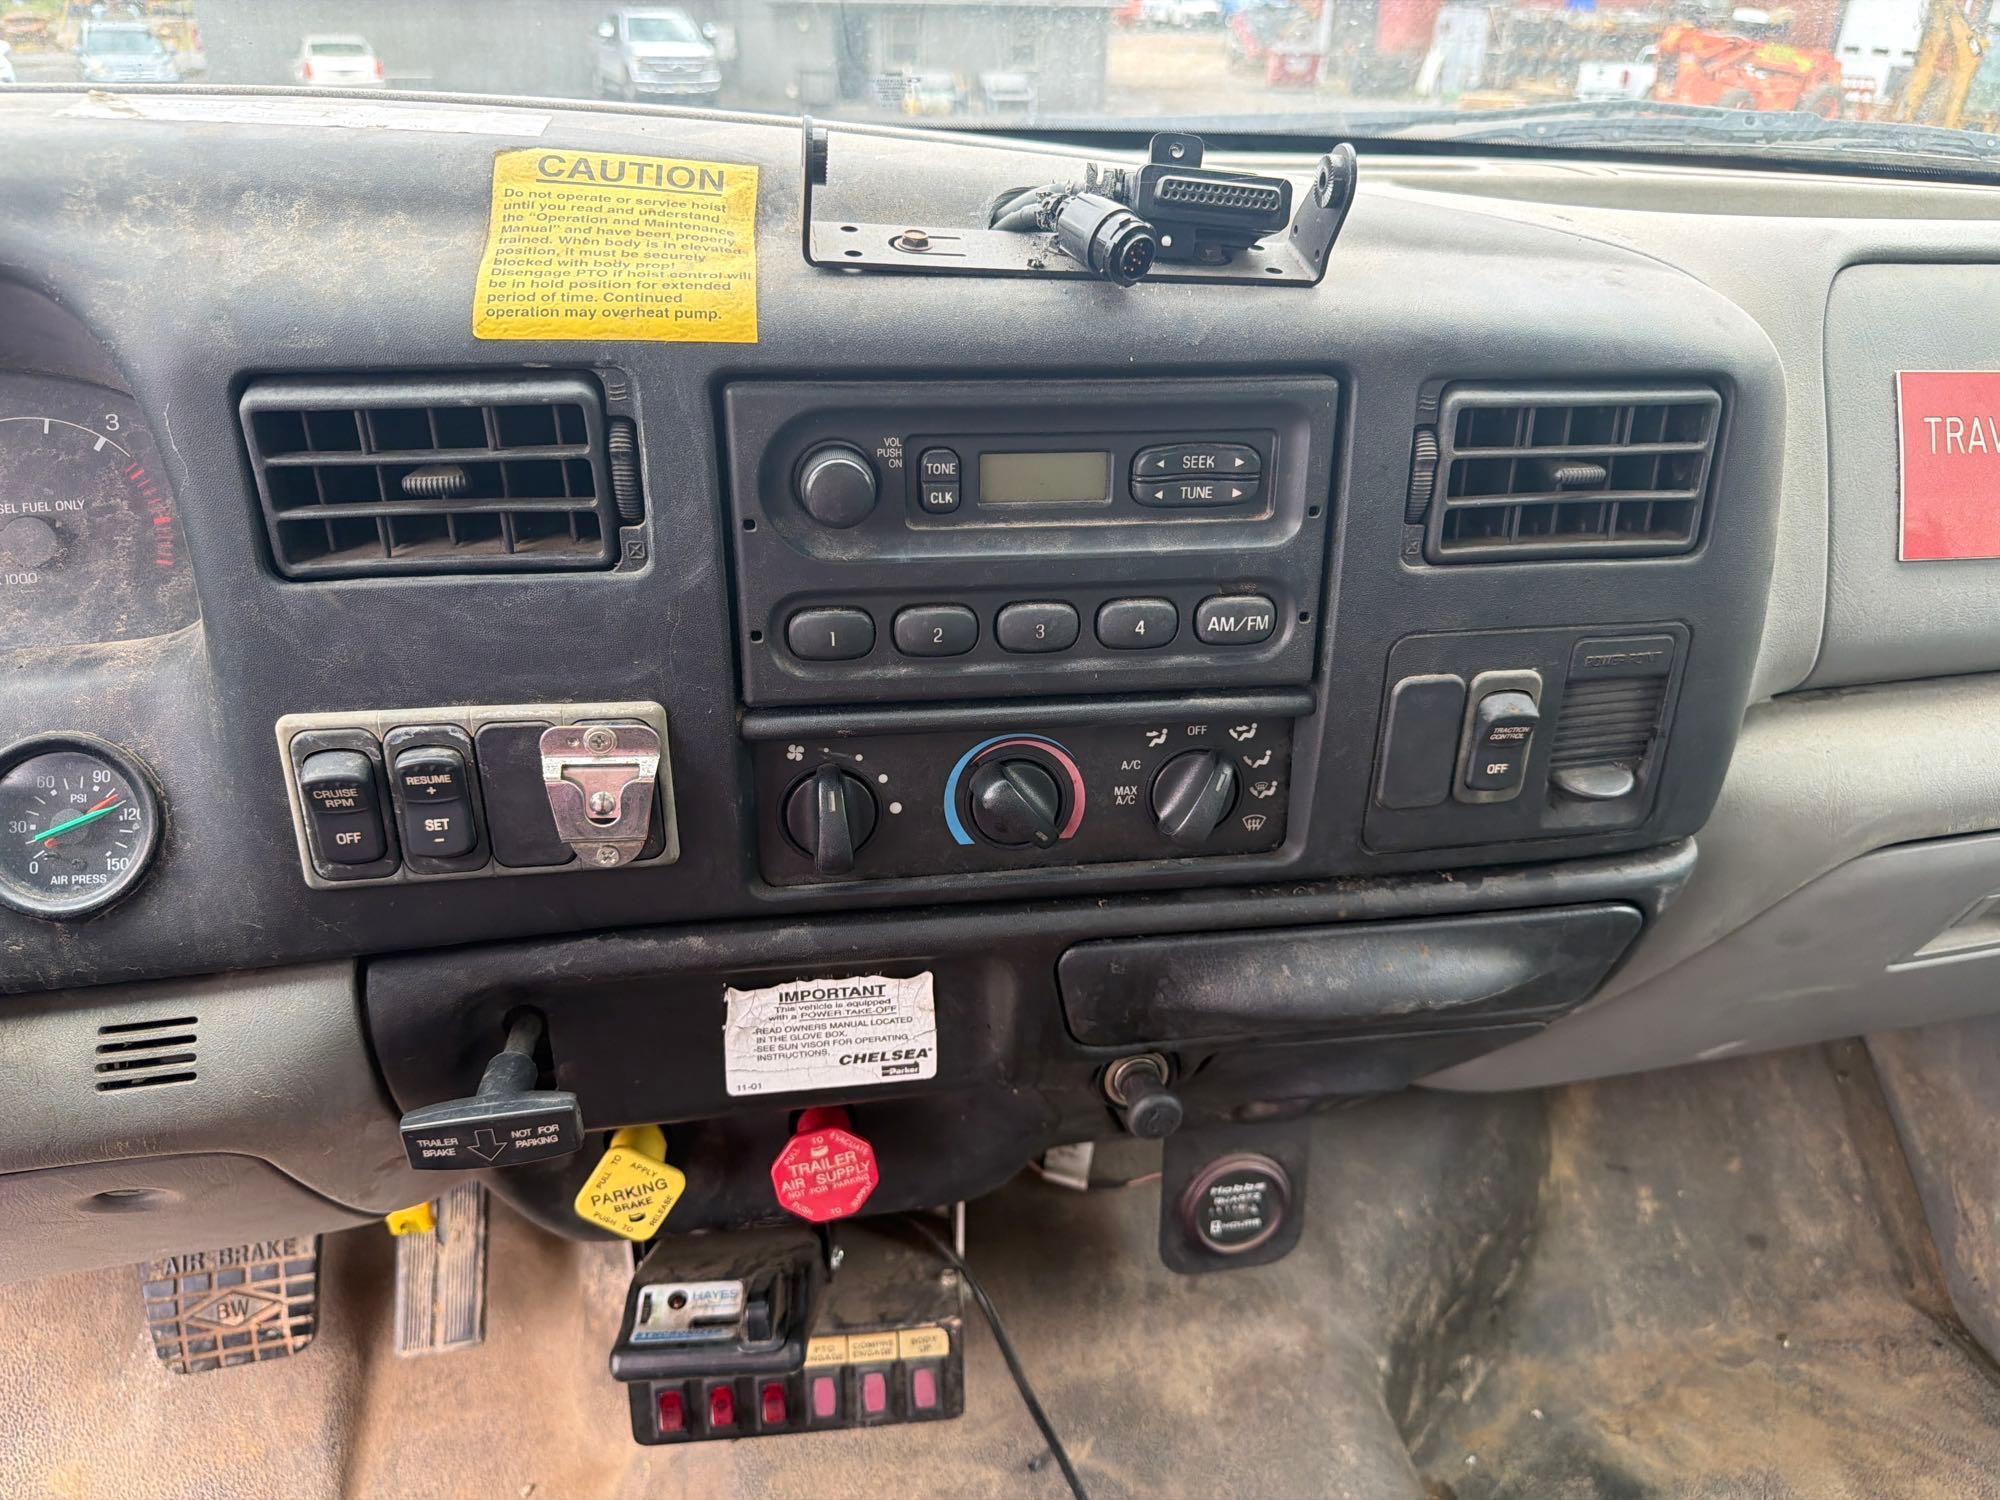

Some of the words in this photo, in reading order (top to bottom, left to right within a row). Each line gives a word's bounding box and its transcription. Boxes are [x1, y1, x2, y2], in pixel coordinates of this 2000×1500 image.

[537, 154, 725, 192] CAUTION
[504, 188, 524, 198] Do
[529, 190, 552, 199] not
[557, 193, 611, 202] operate
[636, 198, 687, 208] service
[691, 201, 727, 213] hoist
[504, 201, 534, 210] until
[540, 203, 566, 211] you
[571, 205, 603, 213] read
[607, 207, 634, 215] and
[639, 208, 720, 223] understand
[503, 213, 524, 222] the
[613, 218, 640, 226] and
[645, 219, 735, 237] Maintenance
[559, 236, 600, 246] When
[604, 238, 640, 249] body
[647, 240, 658, 249] is
[663, 241, 676, 249] in
[564, 226, 592, 234] and
[596, 227, 631, 236] have
[636, 229, 671, 239] been
[676, 232, 736, 246] properly
[495, 247, 560, 257] position,
[565, 248, 574, 256] it
[579, 249, 616, 258] must
[621, 250, 639, 258] be
[643, 252, 706, 263] securely
[493, 258, 553, 267] blocked
[557, 259, 588, 267] with
[593, 260, 630, 269] body
[636, 262, 675, 270] prop!
[491, 268, 571, 278] Disengage
[627, 270, 664, 278] hoist
[727, 272, 751, 280] will
[489, 280, 507, 288] be
[512, 280, 525, 288] in
[531, 280, 564, 288] hold
[569, 280, 631, 290] position
[636, 281, 658, 289] for
[662, 282, 731, 291] extended
[487, 292, 536, 304] period
[541, 292, 557, 302] of
[561, 292, 598, 302] time.
[603, 292, 682, 303] Continued
[486, 307, 559, 319] operation
[565, 308, 597, 320] may
[602, 307, 669, 319] overheat
[674, 309, 722, 321] pump.
[105, 414, 120, 431] 3
[884, 437, 903, 447] VOL
[877, 448, 903, 458] PUSH
[888, 459, 903, 468] ON
[1182, 455, 1215, 469] SEEK
[927, 463, 956, 475] TONE
[930, 492, 953, 504] CLK
[1180, 486, 1213, 499] TUNE
[0, 503, 19, 514] SEL
[22, 501, 52, 513] FUEL
[55, 499, 85, 511] ONLY
[5, 572, 38, 585] 1000
[1134, 620, 1145, 635] 4
[1207, 615, 1269, 632] AM/FM
[933, 627, 943, 643] 2
[1035, 624, 1045, 639] 3
[829, 631, 836, 647] 1
[1187, 725, 1208, 736] OFF
[1493, 726, 1530, 734] TRACTION
[1121, 760, 1141, 770] A/C
[1486, 763, 1510, 775] OFF
[37, 775, 55, 788] 60
[92, 770, 111, 783] 90
[405, 774, 452, 786] RESUME
[313, 788, 358, 799] CRUISE
[1114, 786, 1138, 796] MAX
[70, 794, 87, 803] PSI
[325, 798, 355, 808] RPM
[1116, 795, 1136, 805] A/C
[9, 820, 27, 833] 30
[424, 818, 449, 831] SET
[335, 832, 362, 845] OFF
[29, 862, 39, 874] 0
[106, 858, 129, 871] 150
[50, 875, 68, 885] AIR
[72, 874, 107, 884] PRESS
[779, 984, 886, 1002] IMPORTANT
[798, 1003, 833, 1011] vehicle
[846, 999, 891, 1007] equipped
[800, 1010, 841, 1019] POWER
[845, 1005, 897, 1015] TAKE-OFF
[784, 1023, 827, 1033] OWNERS
[829, 1020, 869, 1029] MANUAL
[870, 1016, 913, 1026] LOCATED
[778, 1043, 798, 1051] SUN
[800, 1040, 830, 1049] VISOR
[832, 1038, 852, 1046] FOR
[854, 1033, 909, 1045] OPERATING
[790, 1032, 822, 1041] GLOVE
[839, 1048, 929, 1065] CHELSEA
[737, 1082, 763, 1091] 11-01
[511, 1128, 532, 1139] NOT
[537, 1124, 560, 1135] FOR
[416, 1137, 458, 1147] TRAILER
[515, 1134, 559, 1149] PARKING
[422, 1148, 456, 1158] BRAKE
[789, 1150, 857, 1178] TRAILER
[596, 1172, 613, 1189] PULL
[611, 1154, 622, 1165] TO
[630, 1162, 658, 1177] APPLY
[781, 1178, 806, 1192] AIR
[816, 1160, 870, 1185] SUPPLY
[591, 1178, 668, 1207] PARKING
[788, 1189, 806, 1199] NOT
[613, 1196, 653, 1213] BRAKE
[649, 1194, 674, 1227] RELEASE
[163, 1252, 205, 1276] AIR
[218, 1237, 298, 1265] BRAKE
[692, 1289, 738, 1300] HAYES
[216, 1298, 251, 1320] BW
